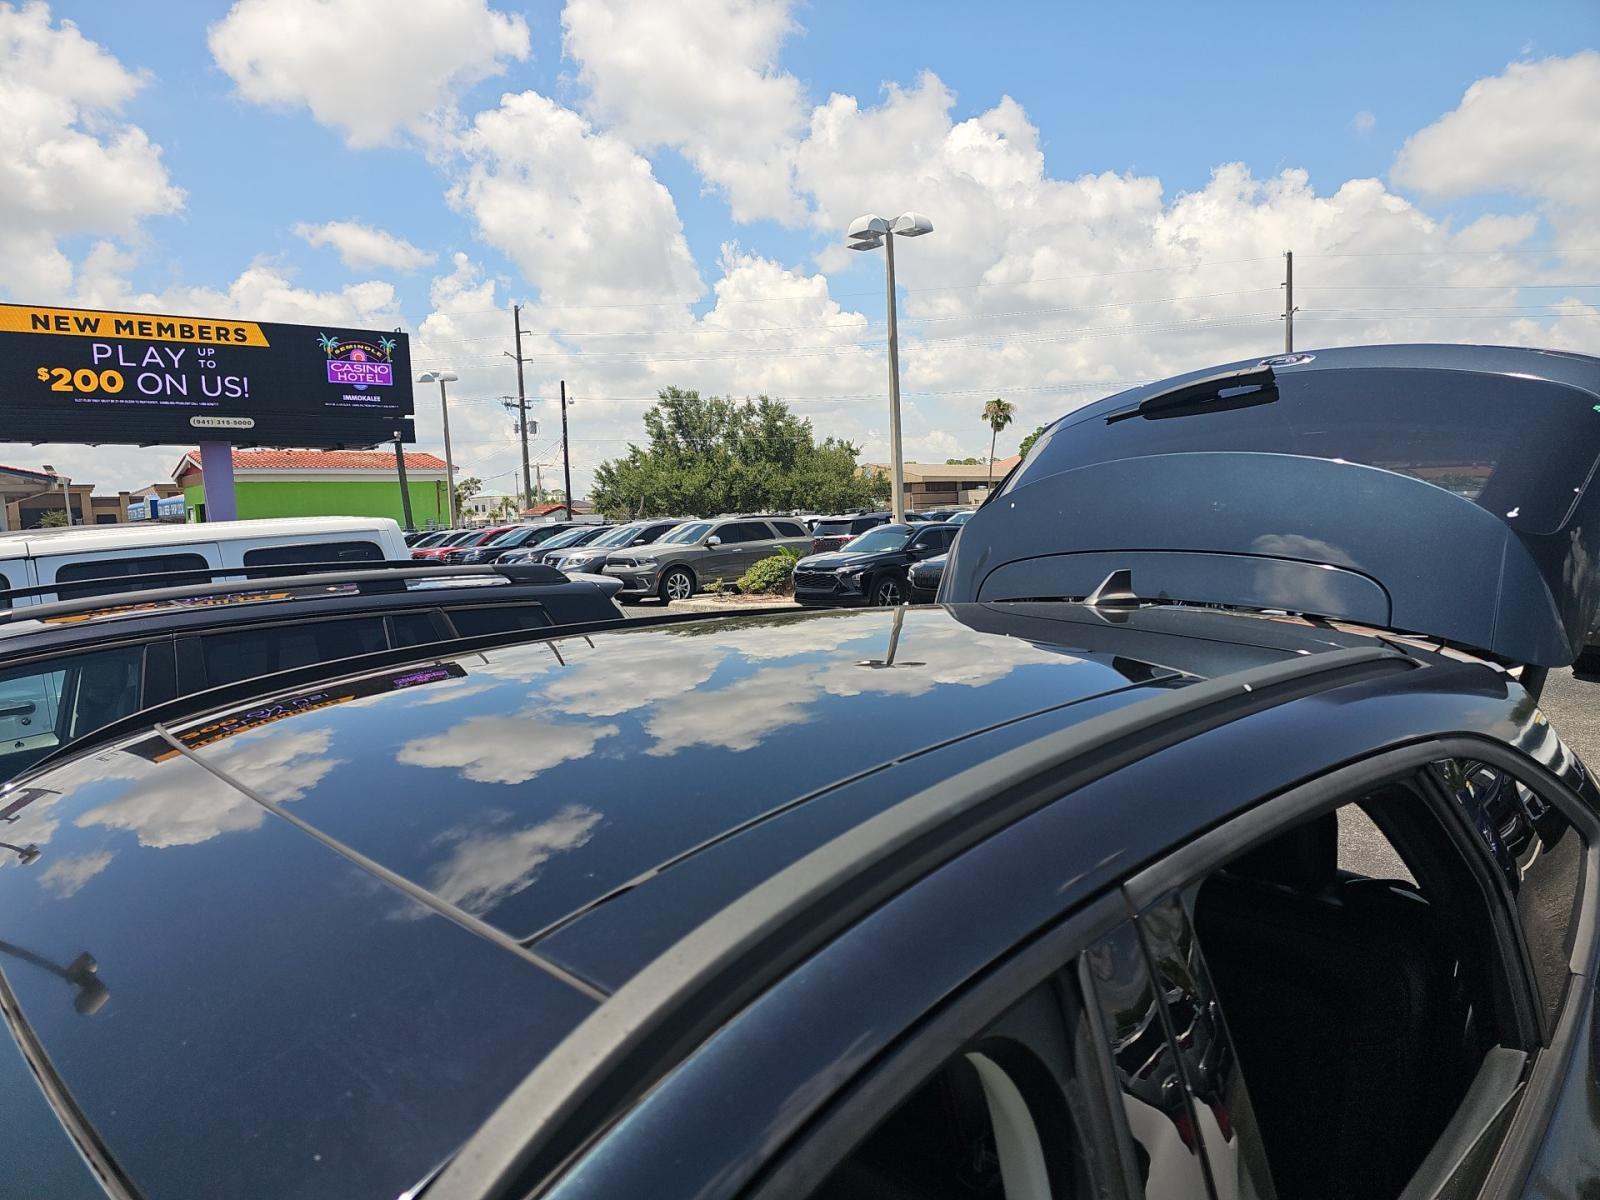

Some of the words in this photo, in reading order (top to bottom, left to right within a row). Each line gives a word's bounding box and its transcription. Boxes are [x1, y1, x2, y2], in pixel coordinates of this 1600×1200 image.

[31, 313, 100, 333] NEW
[114, 319, 248, 343] MEMBERS
[92, 343, 185, 369] PLAY
[197, 347, 215, 357] UP
[334, 344, 383, 358] SEMINOLE
[198, 359, 217, 369] TO
[331, 363, 389, 374] CASINO
[37, 367, 124, 394] $200
[137, 372, 188, 396] ON
[201, 374, 249, 398] US!
[338, 373, 384, 383] HOTEL
[342, 394, 381, 402] IMMOKALEE
